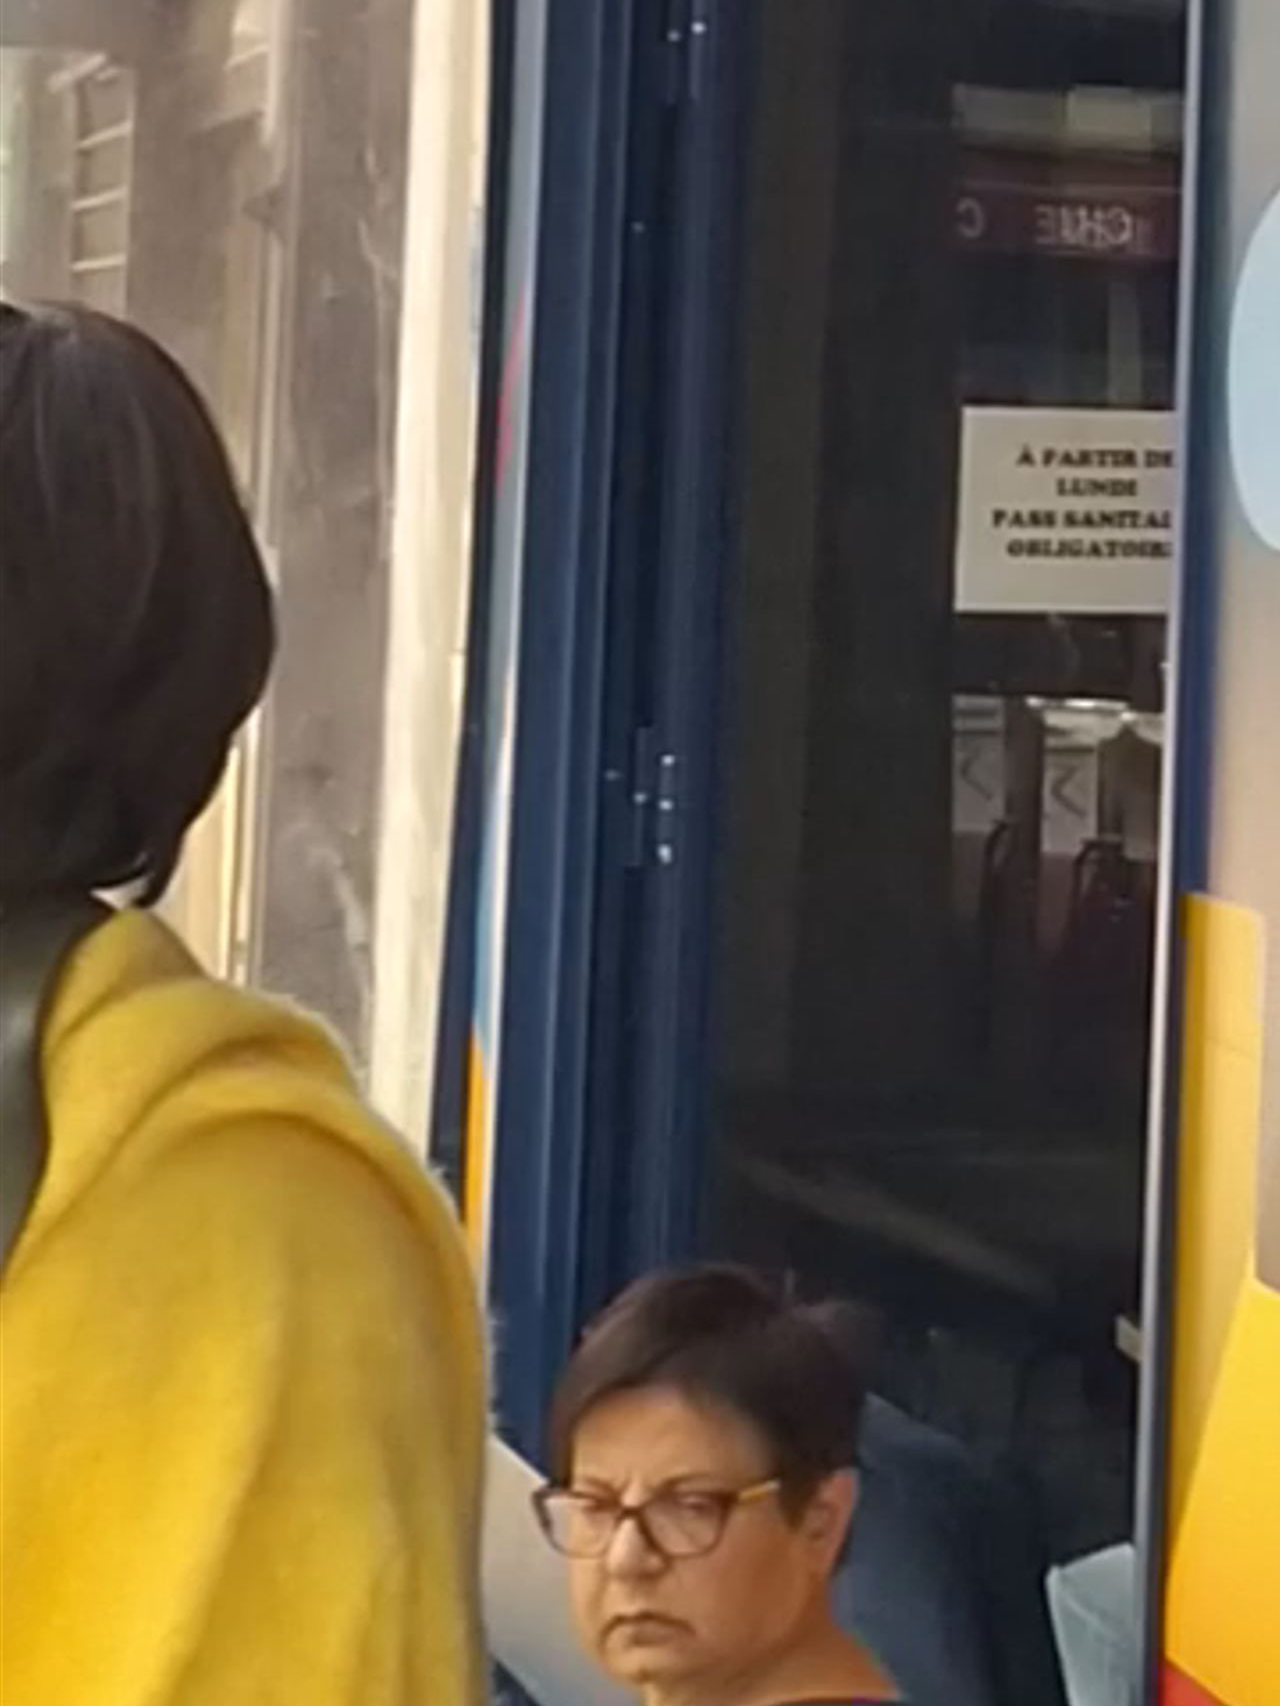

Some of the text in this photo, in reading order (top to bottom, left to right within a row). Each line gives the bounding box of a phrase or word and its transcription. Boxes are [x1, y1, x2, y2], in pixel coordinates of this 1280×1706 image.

[1042, 448, 1138, 468] PARTIR
[1056, 477, 1138, 497] LUNDI
[992, 509, 1057, 529] PASS
